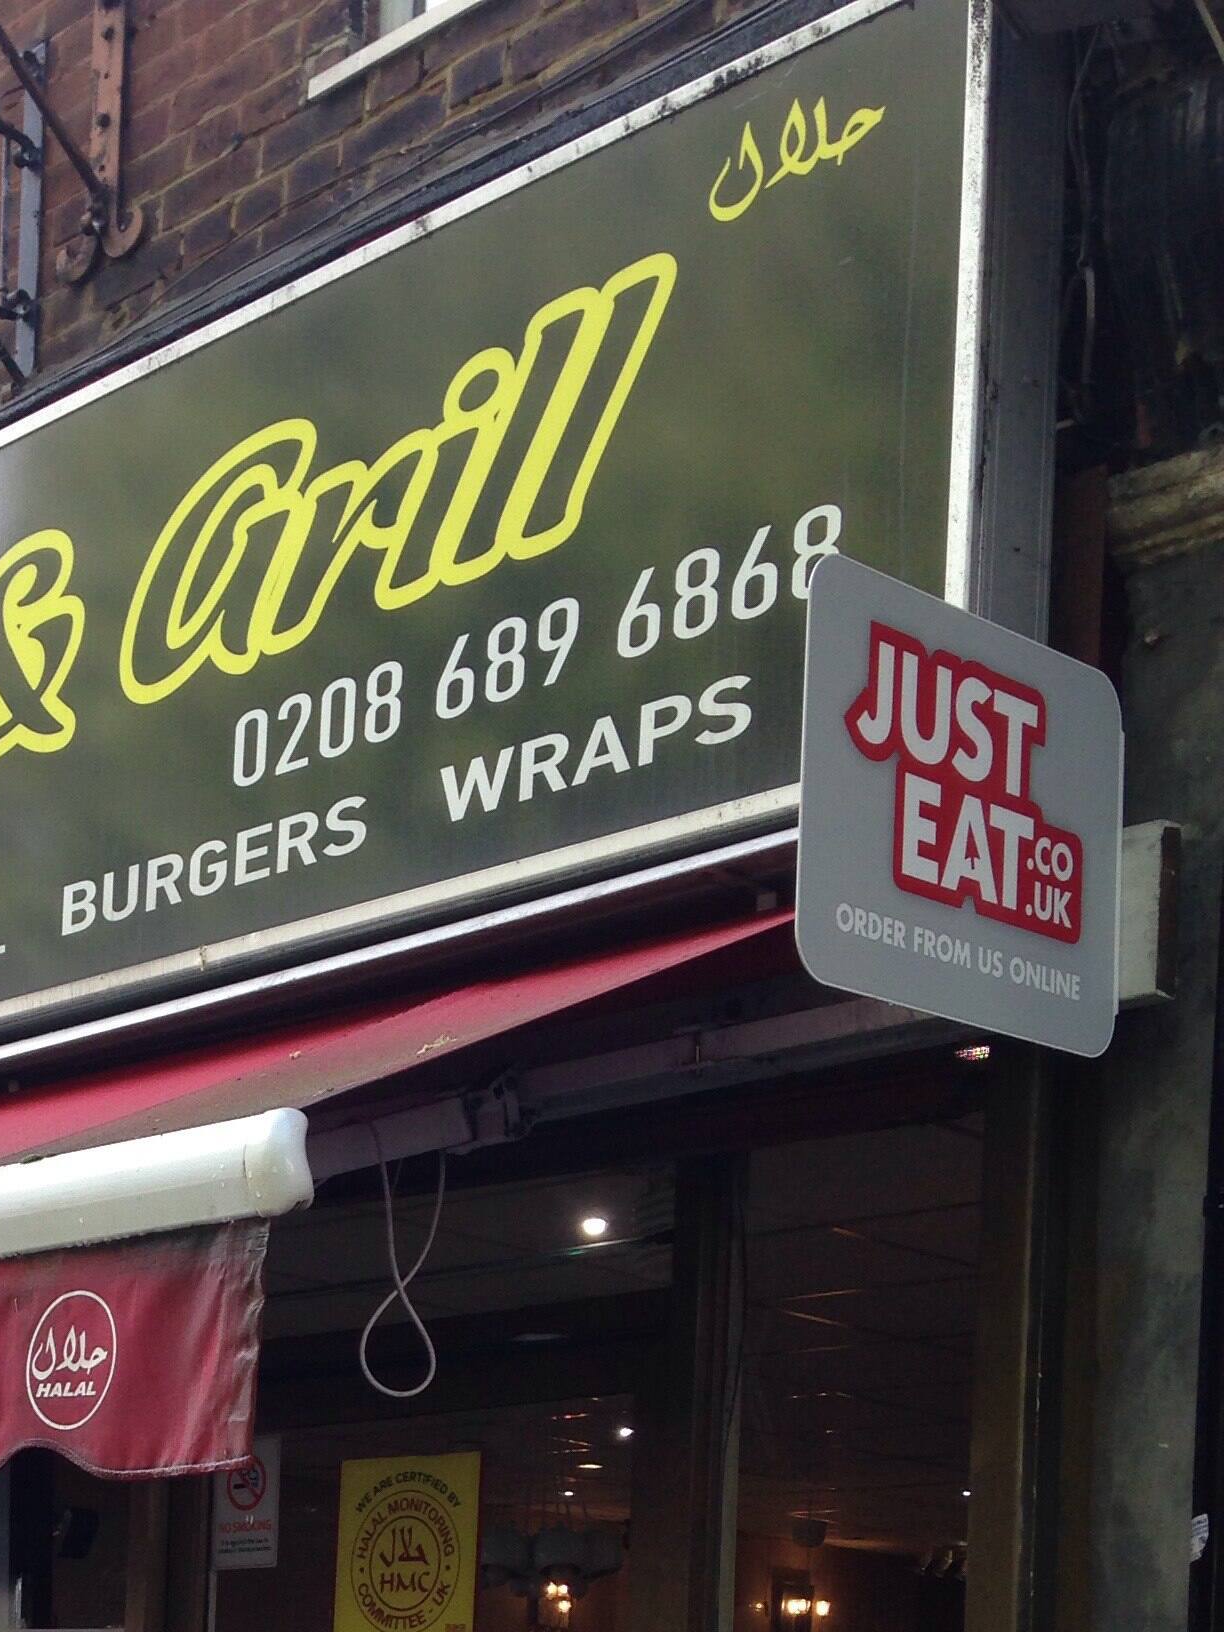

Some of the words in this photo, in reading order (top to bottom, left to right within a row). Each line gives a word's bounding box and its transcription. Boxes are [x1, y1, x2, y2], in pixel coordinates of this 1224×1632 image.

[709, 96, 887, 223] حلال
[119, 252, 678, 705] Grill
[232, 659, 403, 788] 0208
[436, 596, 580, 721] 689
[617, 503, 844, 659] 6868
[856, 641, 1039, 799] JUST
[60, 795, 369, 937] BURGERS
[440, 674, 755, 823] WRAPS
[900, 771, 1036, 912] EAT
[835, 901, 907, 950] ORDER
[912, 926, 973, 970] FROM
[977, 945, 1004, 979] US
[1009, 959, 1082, 1001] ONLINE
[31, 1324, 108, 1380] حلال
[35, 1380, 97, 1398] HALAL
[355, 1492, 372, 1513] WE
[373, 1476, 394, 1496] ARE
[395, 1471, 449, 1495] CERTIFIED
[447, 1491, 462, 1508] BY
[357, 1511, 388, 1559] HALAL
[387, 1497, 456, 1557] MONITORING
[358, 1582, 427, 1630] COMMITTEE
[432, 1579, 451, 1607] UK
[379, 1571, 431, 1593] HMC
